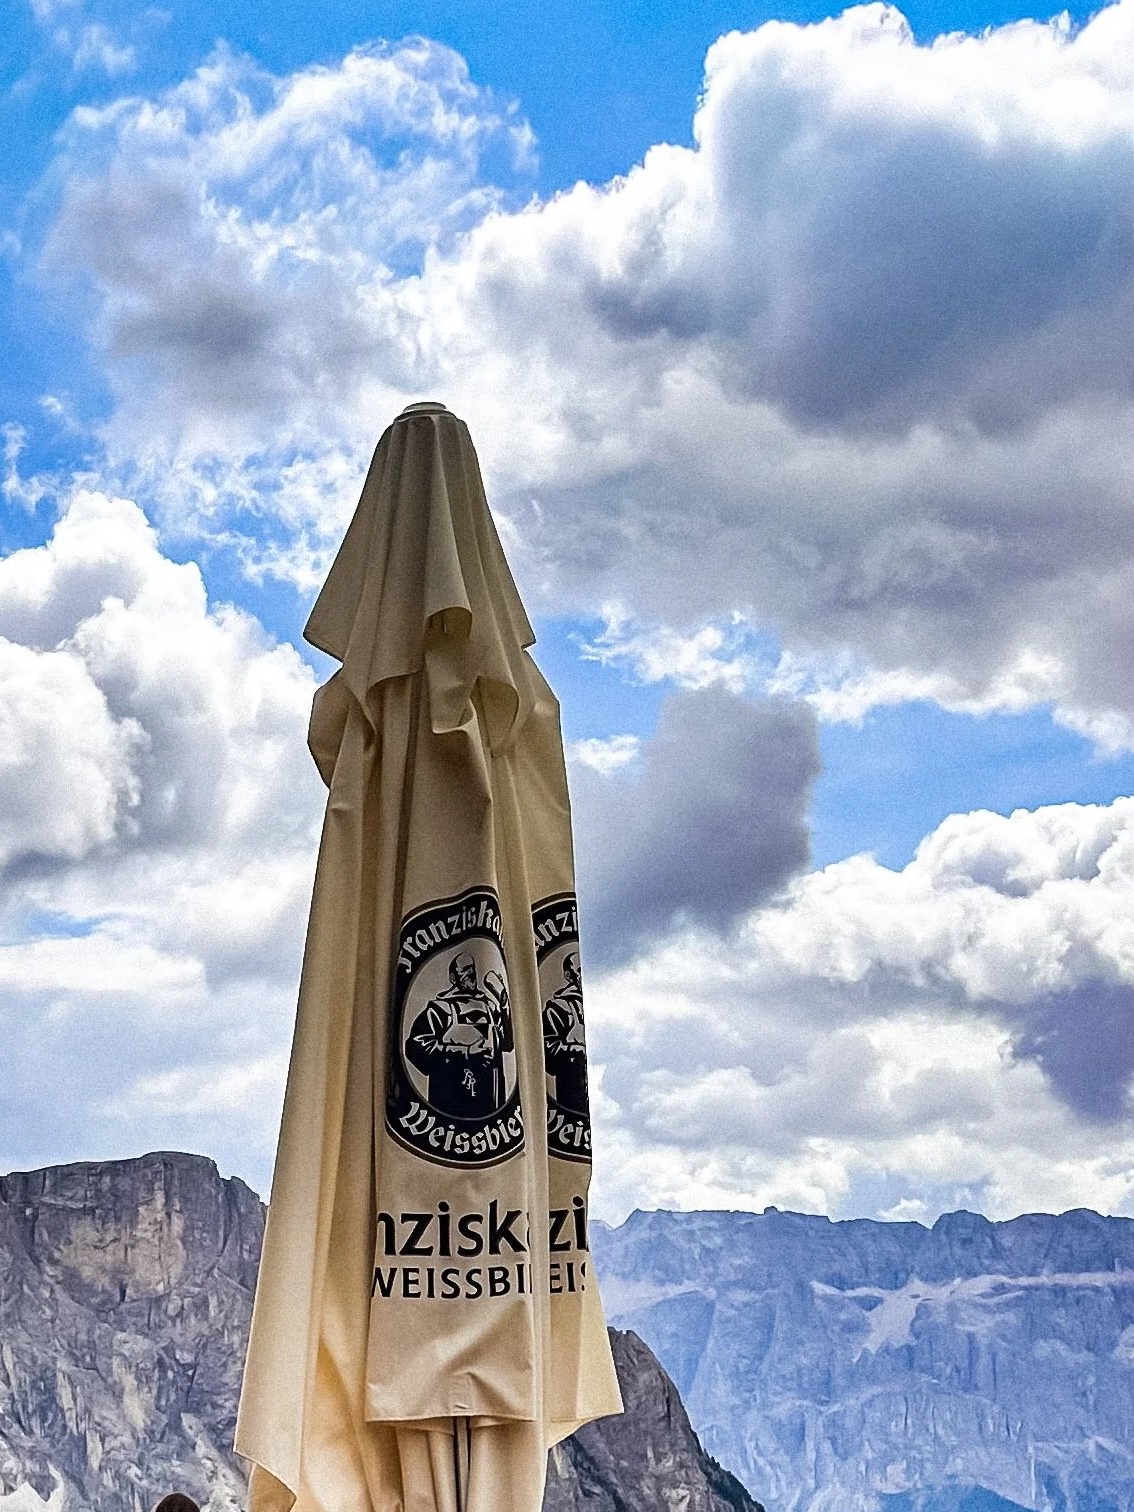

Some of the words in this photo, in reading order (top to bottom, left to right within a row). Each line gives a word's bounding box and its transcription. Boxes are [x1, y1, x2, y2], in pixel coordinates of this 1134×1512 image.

[377, 1199, 530, 1258] nzisk
[549, 1196, 589, 1253] zi
[371, 1263, 532, 1300] WEISSBI
